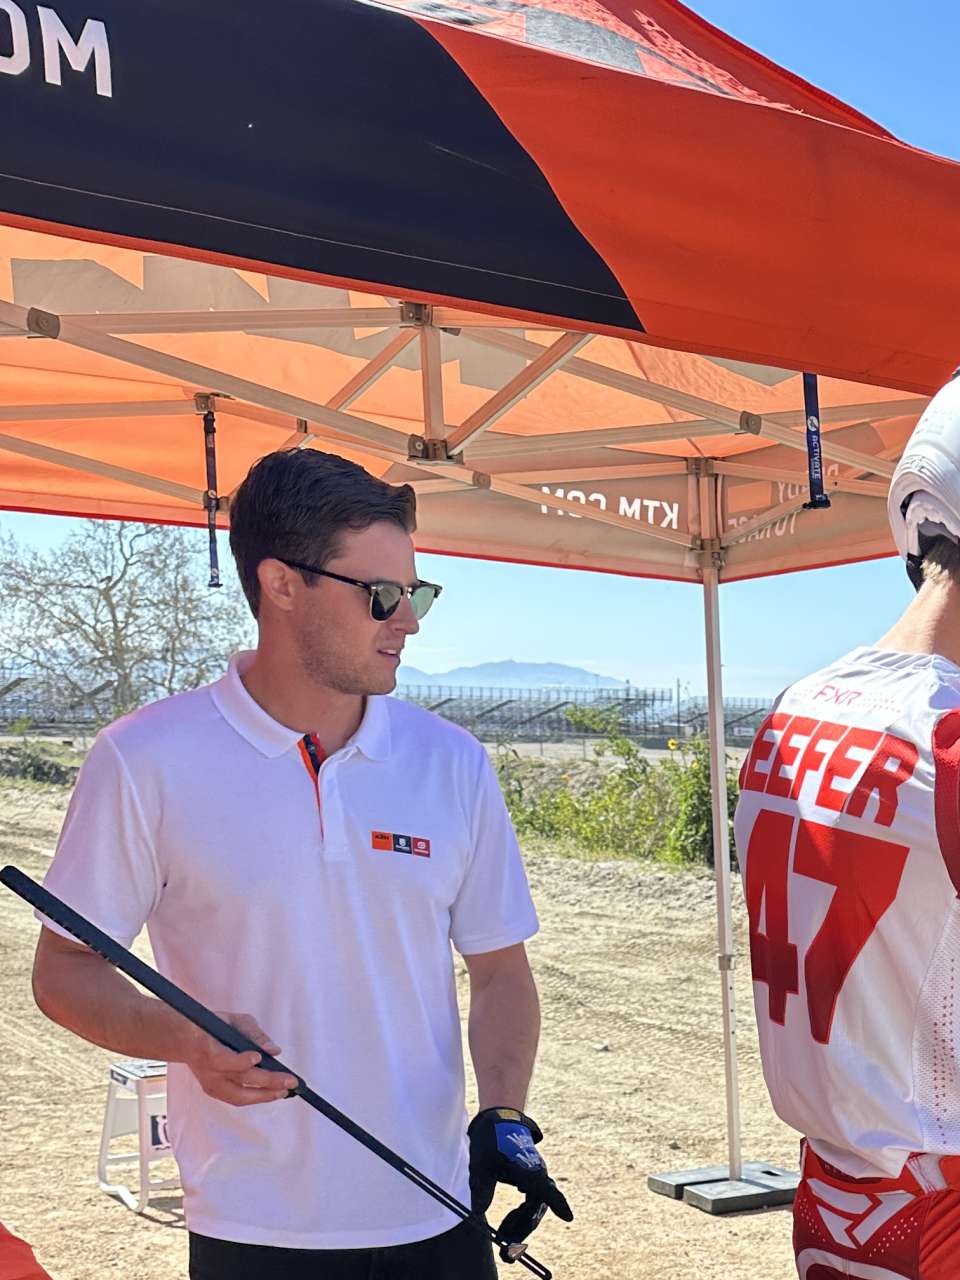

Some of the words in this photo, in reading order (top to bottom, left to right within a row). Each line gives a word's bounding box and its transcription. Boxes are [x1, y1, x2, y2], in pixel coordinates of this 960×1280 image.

[811, 434, 822, 480] ACTIVATE
[813, 684, 864, 706] FXR
[739, 712, 919, 828] EEFER
[745, 808, 911, 1046] 47
